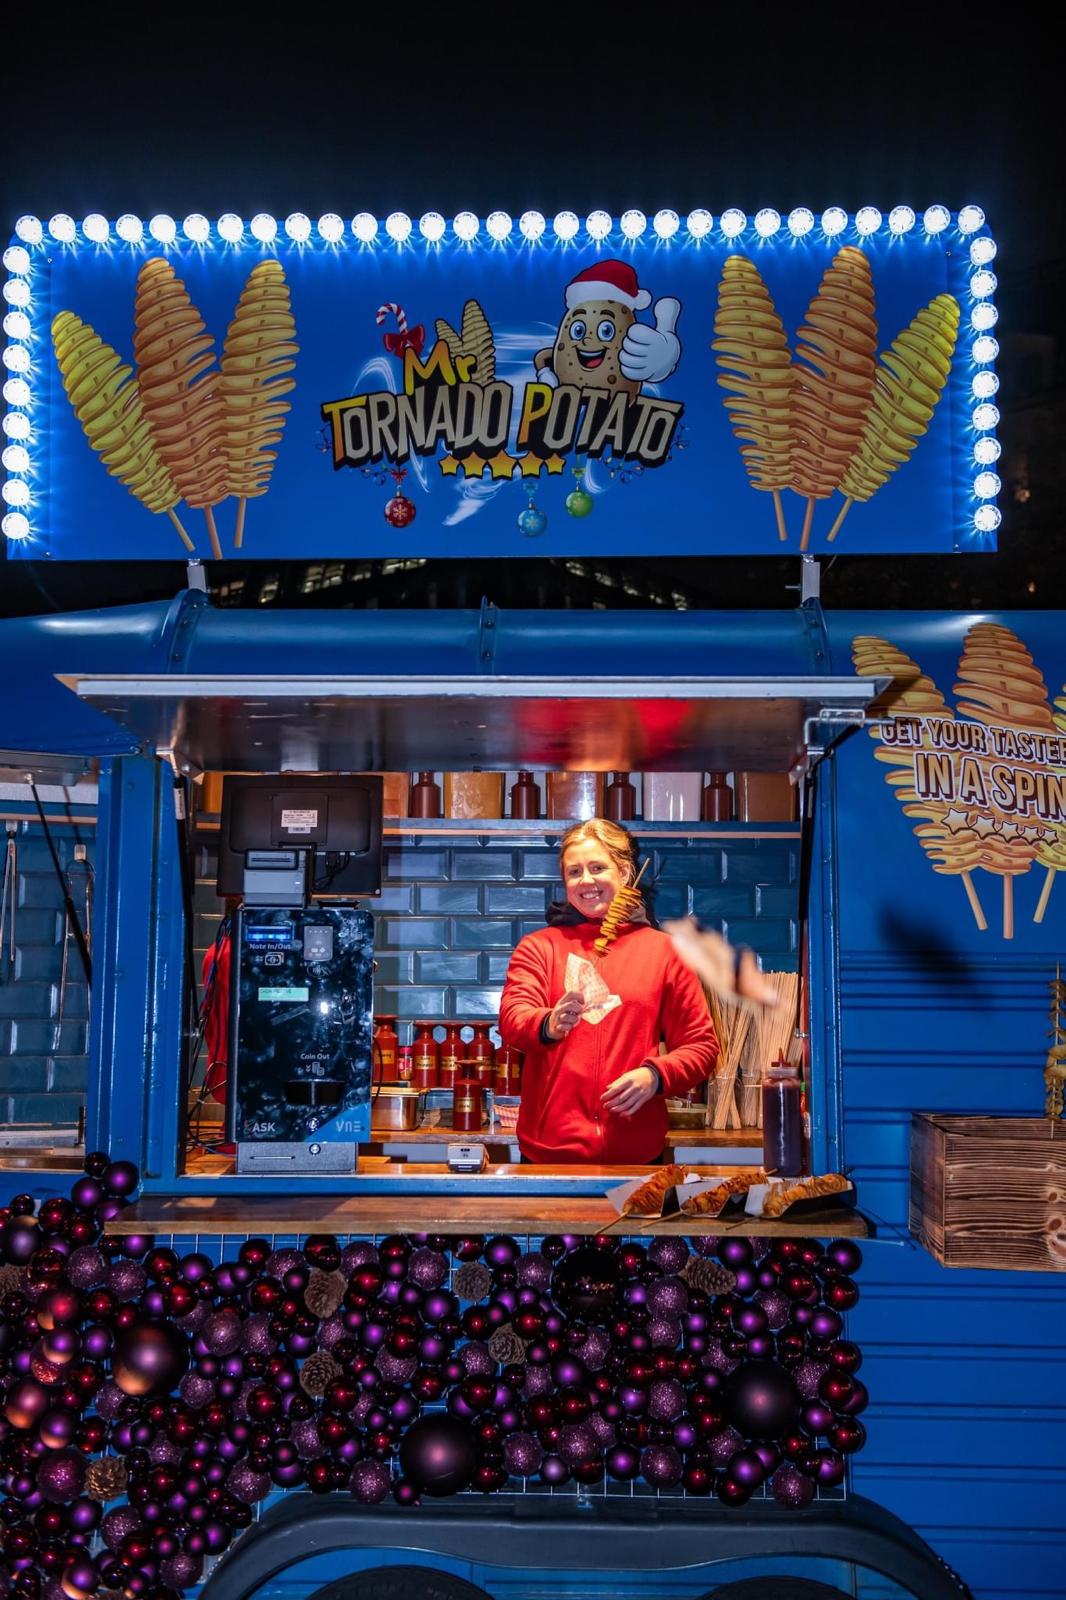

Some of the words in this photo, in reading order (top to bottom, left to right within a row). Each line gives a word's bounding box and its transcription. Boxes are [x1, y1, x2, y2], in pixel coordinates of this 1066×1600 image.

[403, 338, 477, 396] Mr
[320, 381, 514, 471] TORNADO
[516, 381, 684, 468] POTATO
[881, 717, 922, 745] GET
[926, 718, 988, 752] YOUR
[915, 752, 953, 799] IN
[960, 757, 988, 806] A
[991, 764, 1066, 821] SPIN
[252, 1122, 276, 1132] ASK
